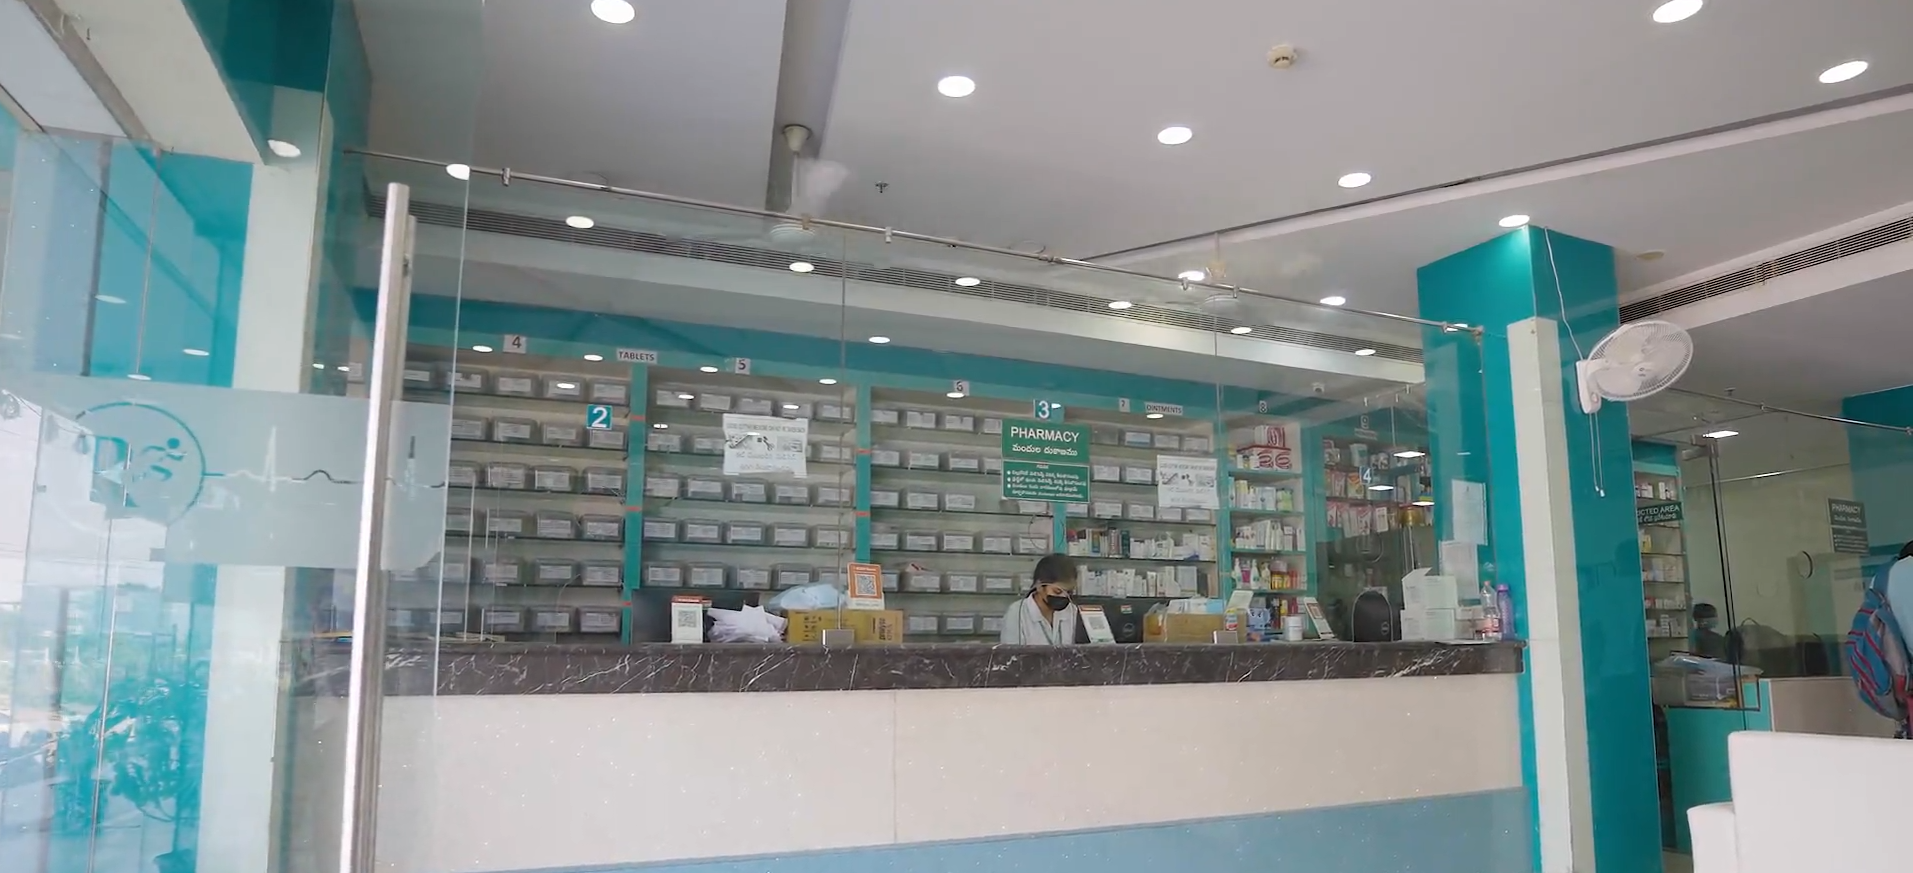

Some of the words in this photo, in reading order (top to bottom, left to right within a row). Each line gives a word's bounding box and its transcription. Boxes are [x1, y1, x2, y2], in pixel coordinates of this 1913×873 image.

[512, 336, 522, 348] 4
[619, 351, 655, 361] TABLETS
[738, 359, 746, 370] 5
[956, 381, 963, 391] 6
[1038, 400, 1050, 419] 3
[1146, 404, 1182, 414] OINTMENTS
[591, 407, 608, 428] 2
[1010, 426, 1080, 443] PHARMACY
[1362, 467, 1372, 483] 4
[1660, 504, 1680, 513] AREA
[1831, 503, 1861, 514] PHARMACY
